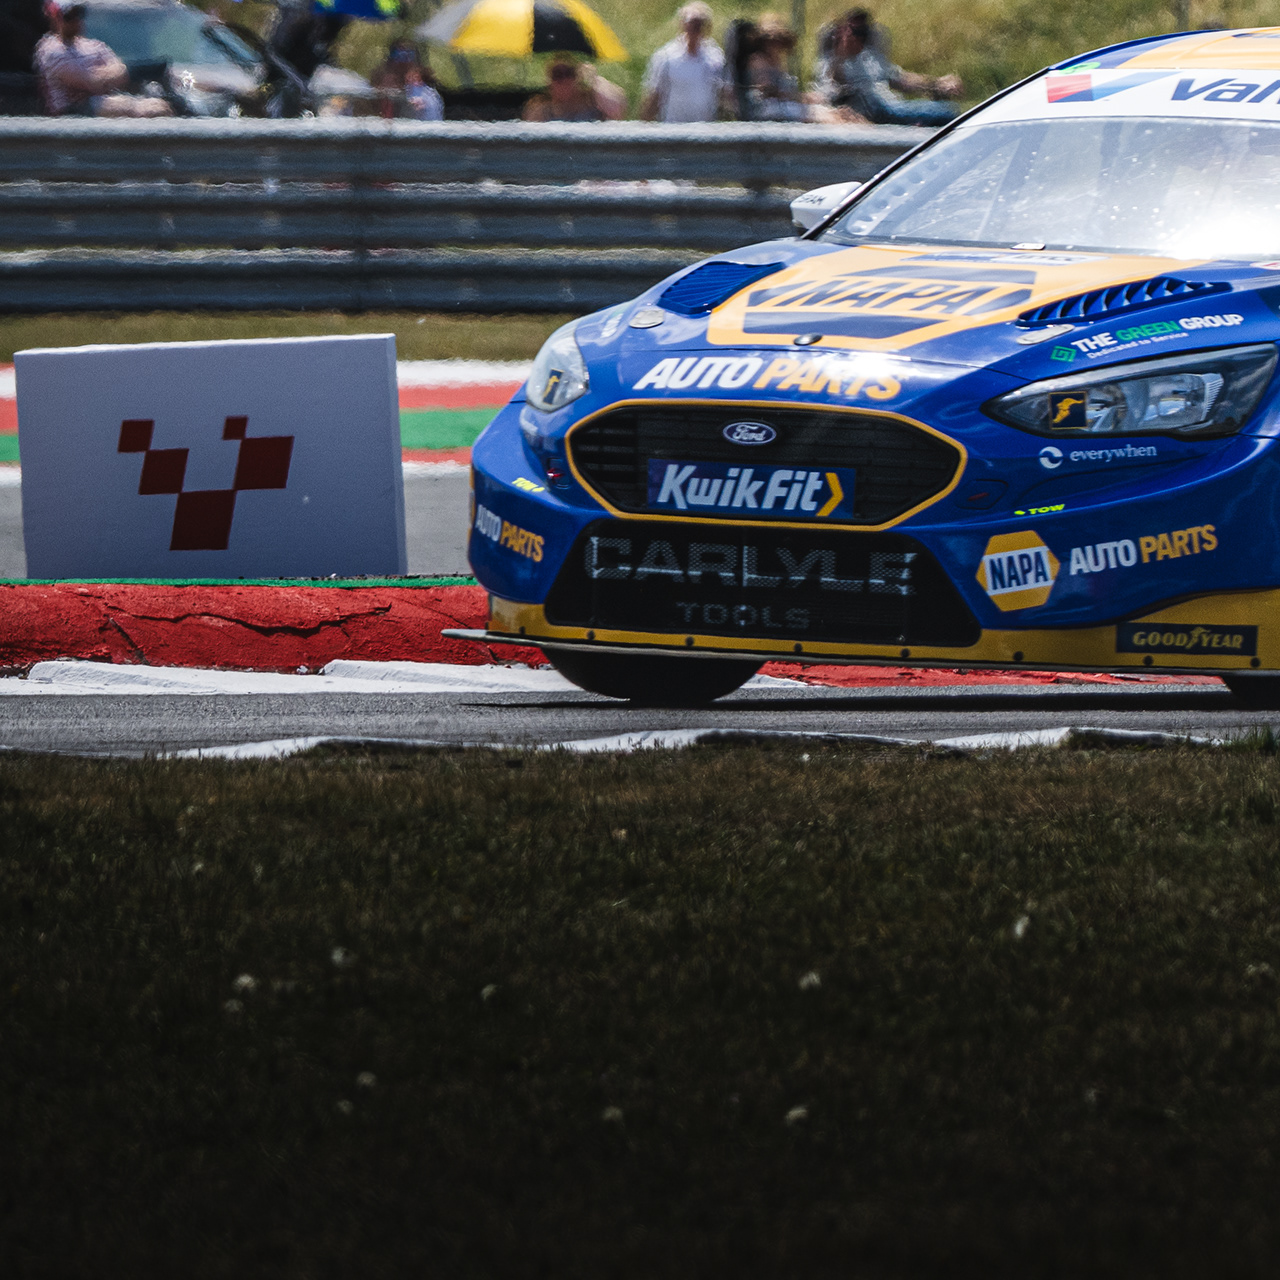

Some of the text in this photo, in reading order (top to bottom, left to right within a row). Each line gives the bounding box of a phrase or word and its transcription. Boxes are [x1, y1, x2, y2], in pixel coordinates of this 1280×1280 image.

[776, 280, 1000, 315] NAPA
[1070, 313, 1244, 353] THE GREEN GROUP
[1086, 331, 1189, 360] Dedicated to Service
[633, 357, 903, 401] AUTO PARTS
[734, 423, 766, 442] Ford
[1069, 444, 1158, 463] everywhen
[1028, 503, 1065, 515] TOW
[475, 503, 545, 562] AUTO PARTS
[584, 536, 919, 596] CARLYLE
[988, 524, 1218, 591] NAPA AUTO PARTS
[676, 601, 811, 630] TOOLS
[1131, 628, 1245, 651] GOODYEAR
